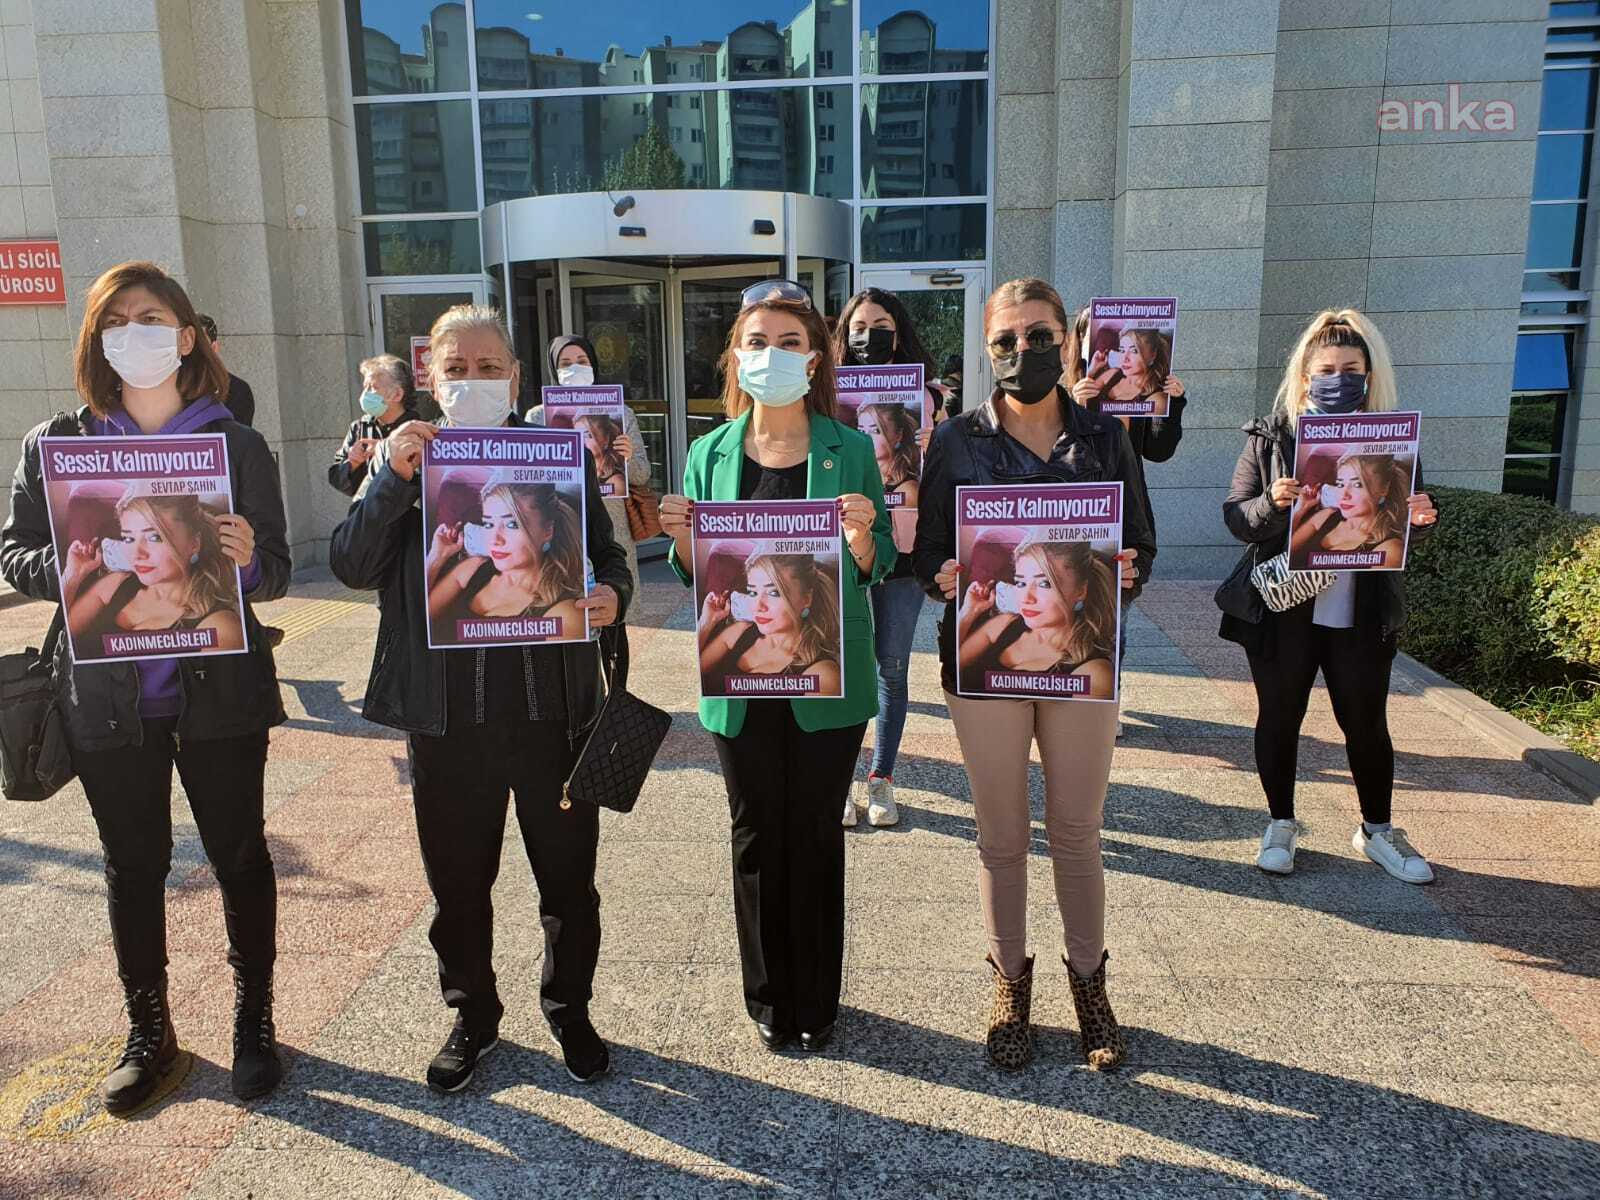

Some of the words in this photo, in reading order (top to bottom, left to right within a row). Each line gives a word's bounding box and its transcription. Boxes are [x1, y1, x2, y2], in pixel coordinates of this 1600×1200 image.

[0, 249, 14, 269] Lİ
[18, 249, 61, 269] SİCİL
[0, 274, 56, 294] ÜROSU
[1095, 303, 1120, 316] Sessiz
[837, 374, 857, 388] ssiz
[859, 373, 917, 389] Kalmıyoruz!
[1304, 422, 1340, 439] Sessiz
[1342, 421, 1411, 440] Kalmıyoruz!
[432, 438, 480, 460] Sessiz
[482, 439, 572, 462] Kalmıyoruz!
[53, 450, 110, 474] Sessiz
[112, 448, 215, 474] Kalmıyoruz!
[513, 469, 544, 481] SEVTAP
[151, 481, 185, 494] SEVTAP
[966, 496, 1014, 519] Sessiz
[1017, 495, 1111, 520] Kalmıyoruz!
[700, 512, 744, 532] Sessiz
[746, 511, 830, 534] Kalmıyoruz!
[1048, 527, 1080, 540] SEVTAP
[775, 541, 803, 552] SEVTAP
[463, 619, 556, 638] KADINMECLİSLERİ
[110, 630, 212, 652] KADINMECLİSLERİ
[730, 676, 815, 691] KADINMECLİSLERİ
[991, 674, 1084, 692] KADINMECLİSLERİ
